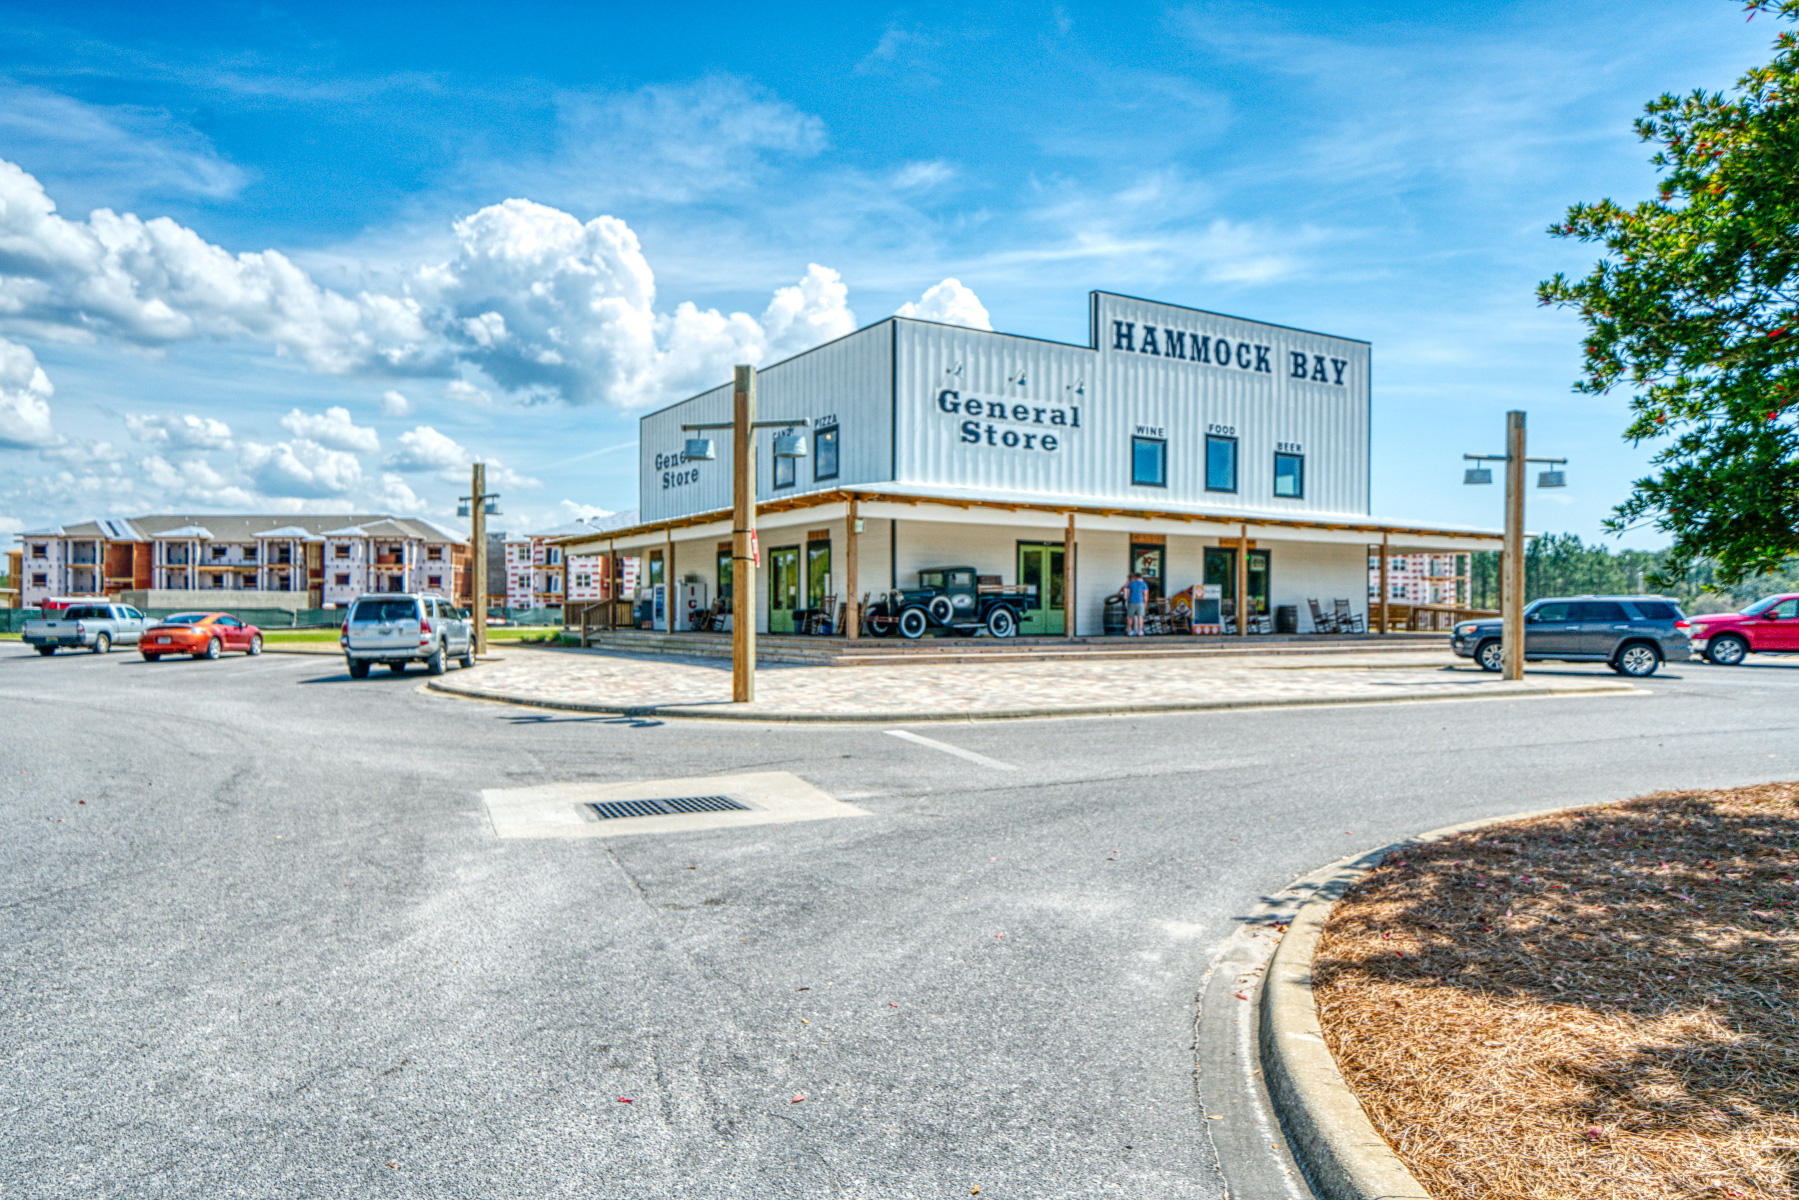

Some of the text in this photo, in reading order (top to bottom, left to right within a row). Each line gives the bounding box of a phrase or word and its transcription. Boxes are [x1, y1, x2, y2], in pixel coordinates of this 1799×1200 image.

[1112, 319, 1348, 386] HAMMOCK BAY
[938, 389, 1081, 428] General
[815, 414, 837, 428] PIZZA
[1136, 425, 1165, 437] WINE
[1208, 423, 1236, 435] FOOD
[960, 420, 1058, 451] Store
[1277, 442, 1302, 452] BEER
[655, 450, 692, 471] Gene
[663, 468, 698, 490] Store
